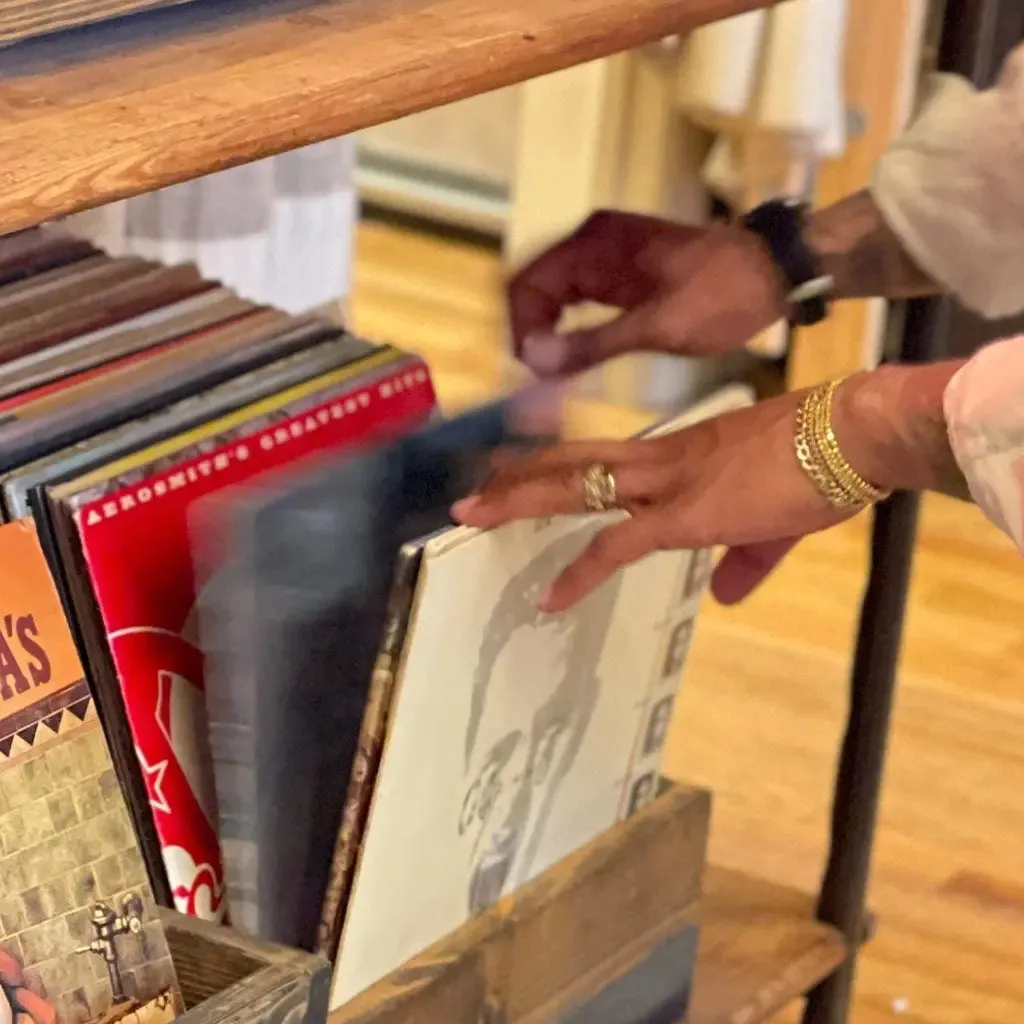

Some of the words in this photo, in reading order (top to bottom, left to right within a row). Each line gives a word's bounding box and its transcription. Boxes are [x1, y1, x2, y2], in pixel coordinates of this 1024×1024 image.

[86, 443, 250, 527] AEROSMITH'S
[259, 391, 371, 451] GREATEST
[379, 367, 427, 399] HITS
